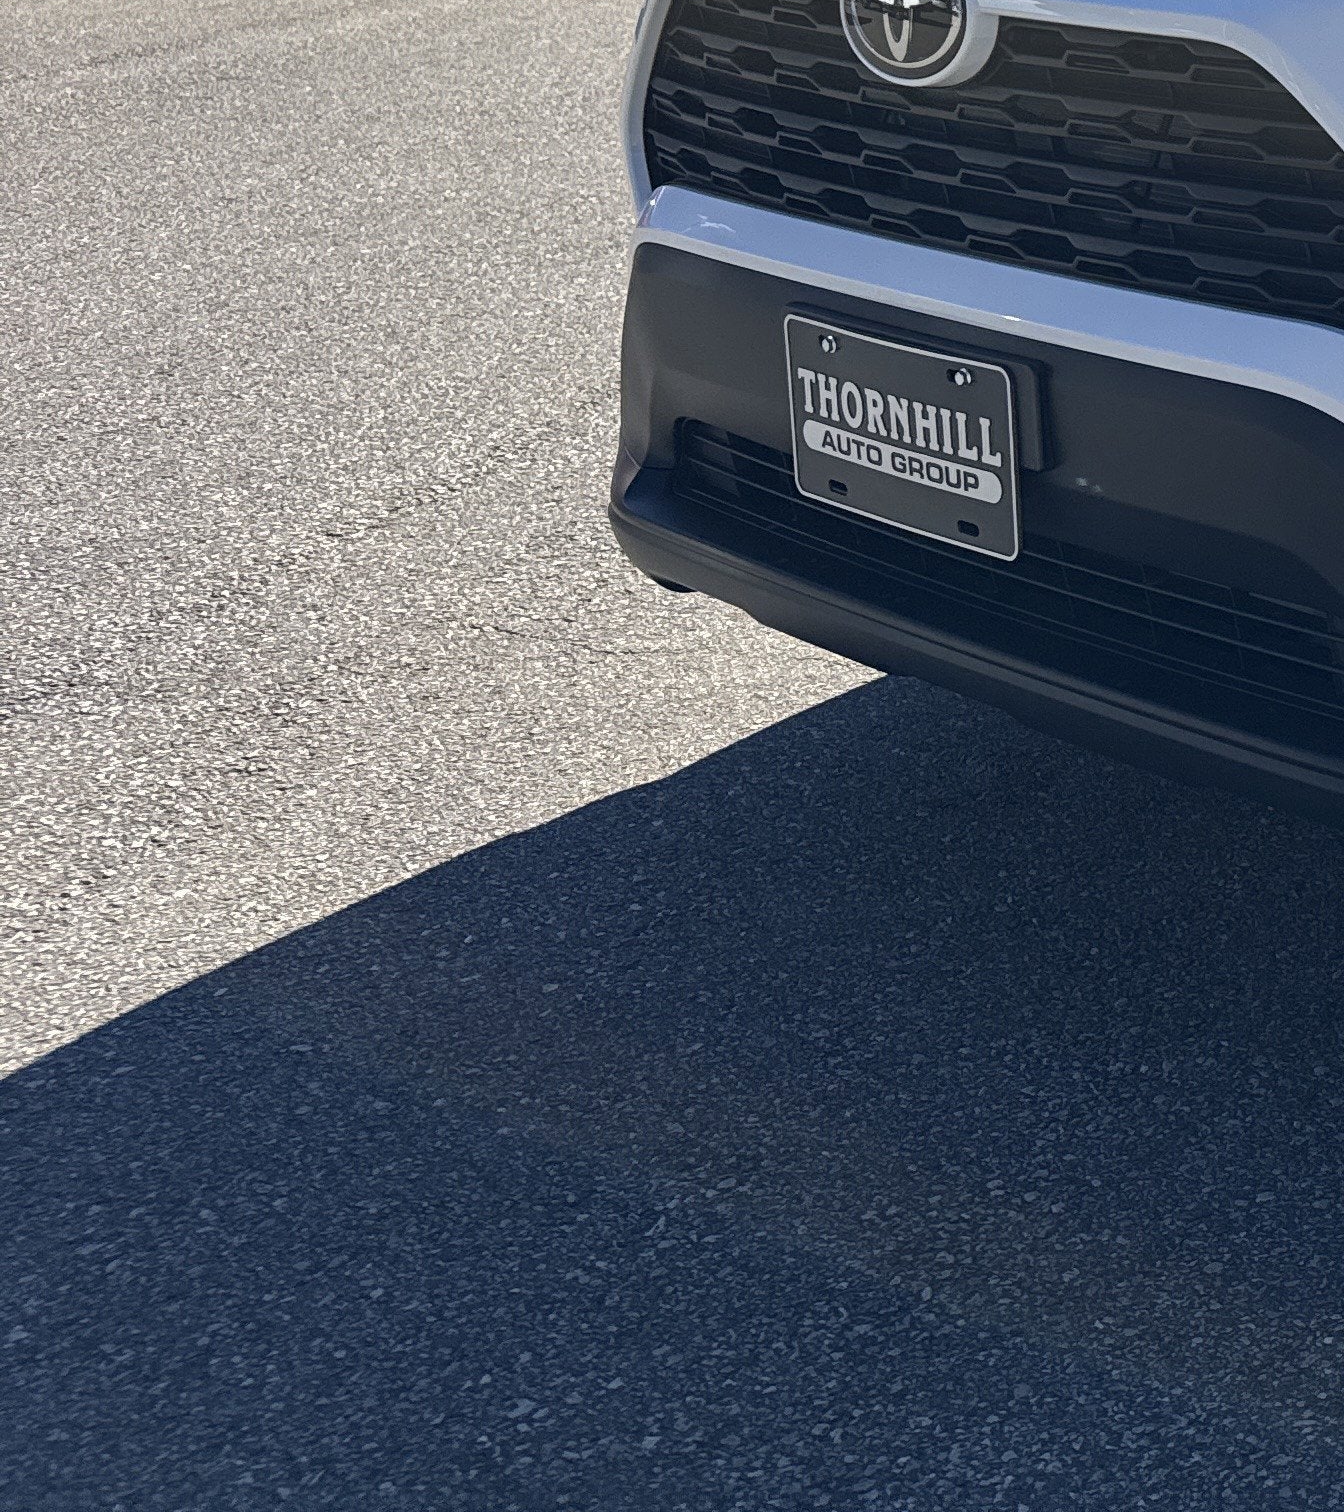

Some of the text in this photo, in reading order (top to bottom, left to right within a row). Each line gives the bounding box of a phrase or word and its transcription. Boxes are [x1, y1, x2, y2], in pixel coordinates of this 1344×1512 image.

[798, 368, 1001, 467] THORNHILL
[822, 431, 979, 492] AUTO GROUP
